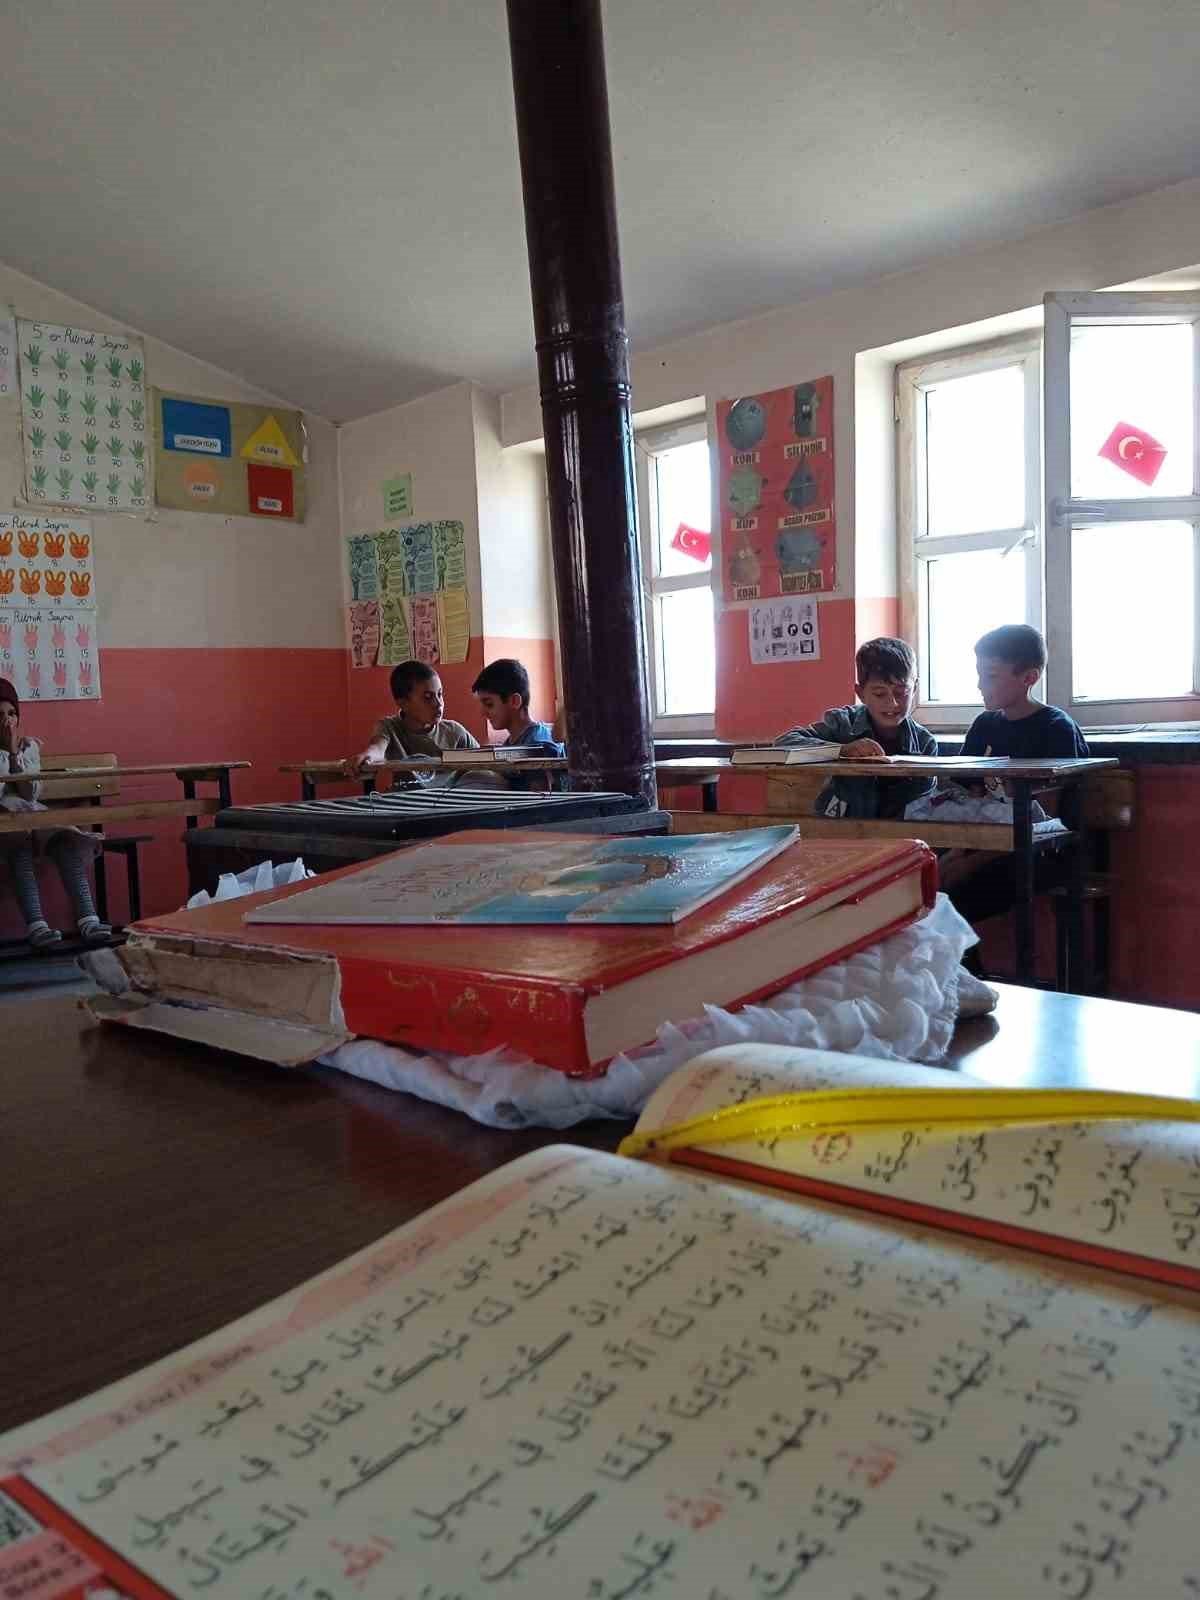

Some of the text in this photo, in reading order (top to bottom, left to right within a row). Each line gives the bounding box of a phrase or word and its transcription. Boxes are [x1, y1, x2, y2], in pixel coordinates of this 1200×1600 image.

[31, 368, 39, 377] 5
[131, 383, 142, 392] 25
[31, 409, 43, 420] 30
[130, 422, 144, 432] 50
[55, 649, 65, 658] 12
